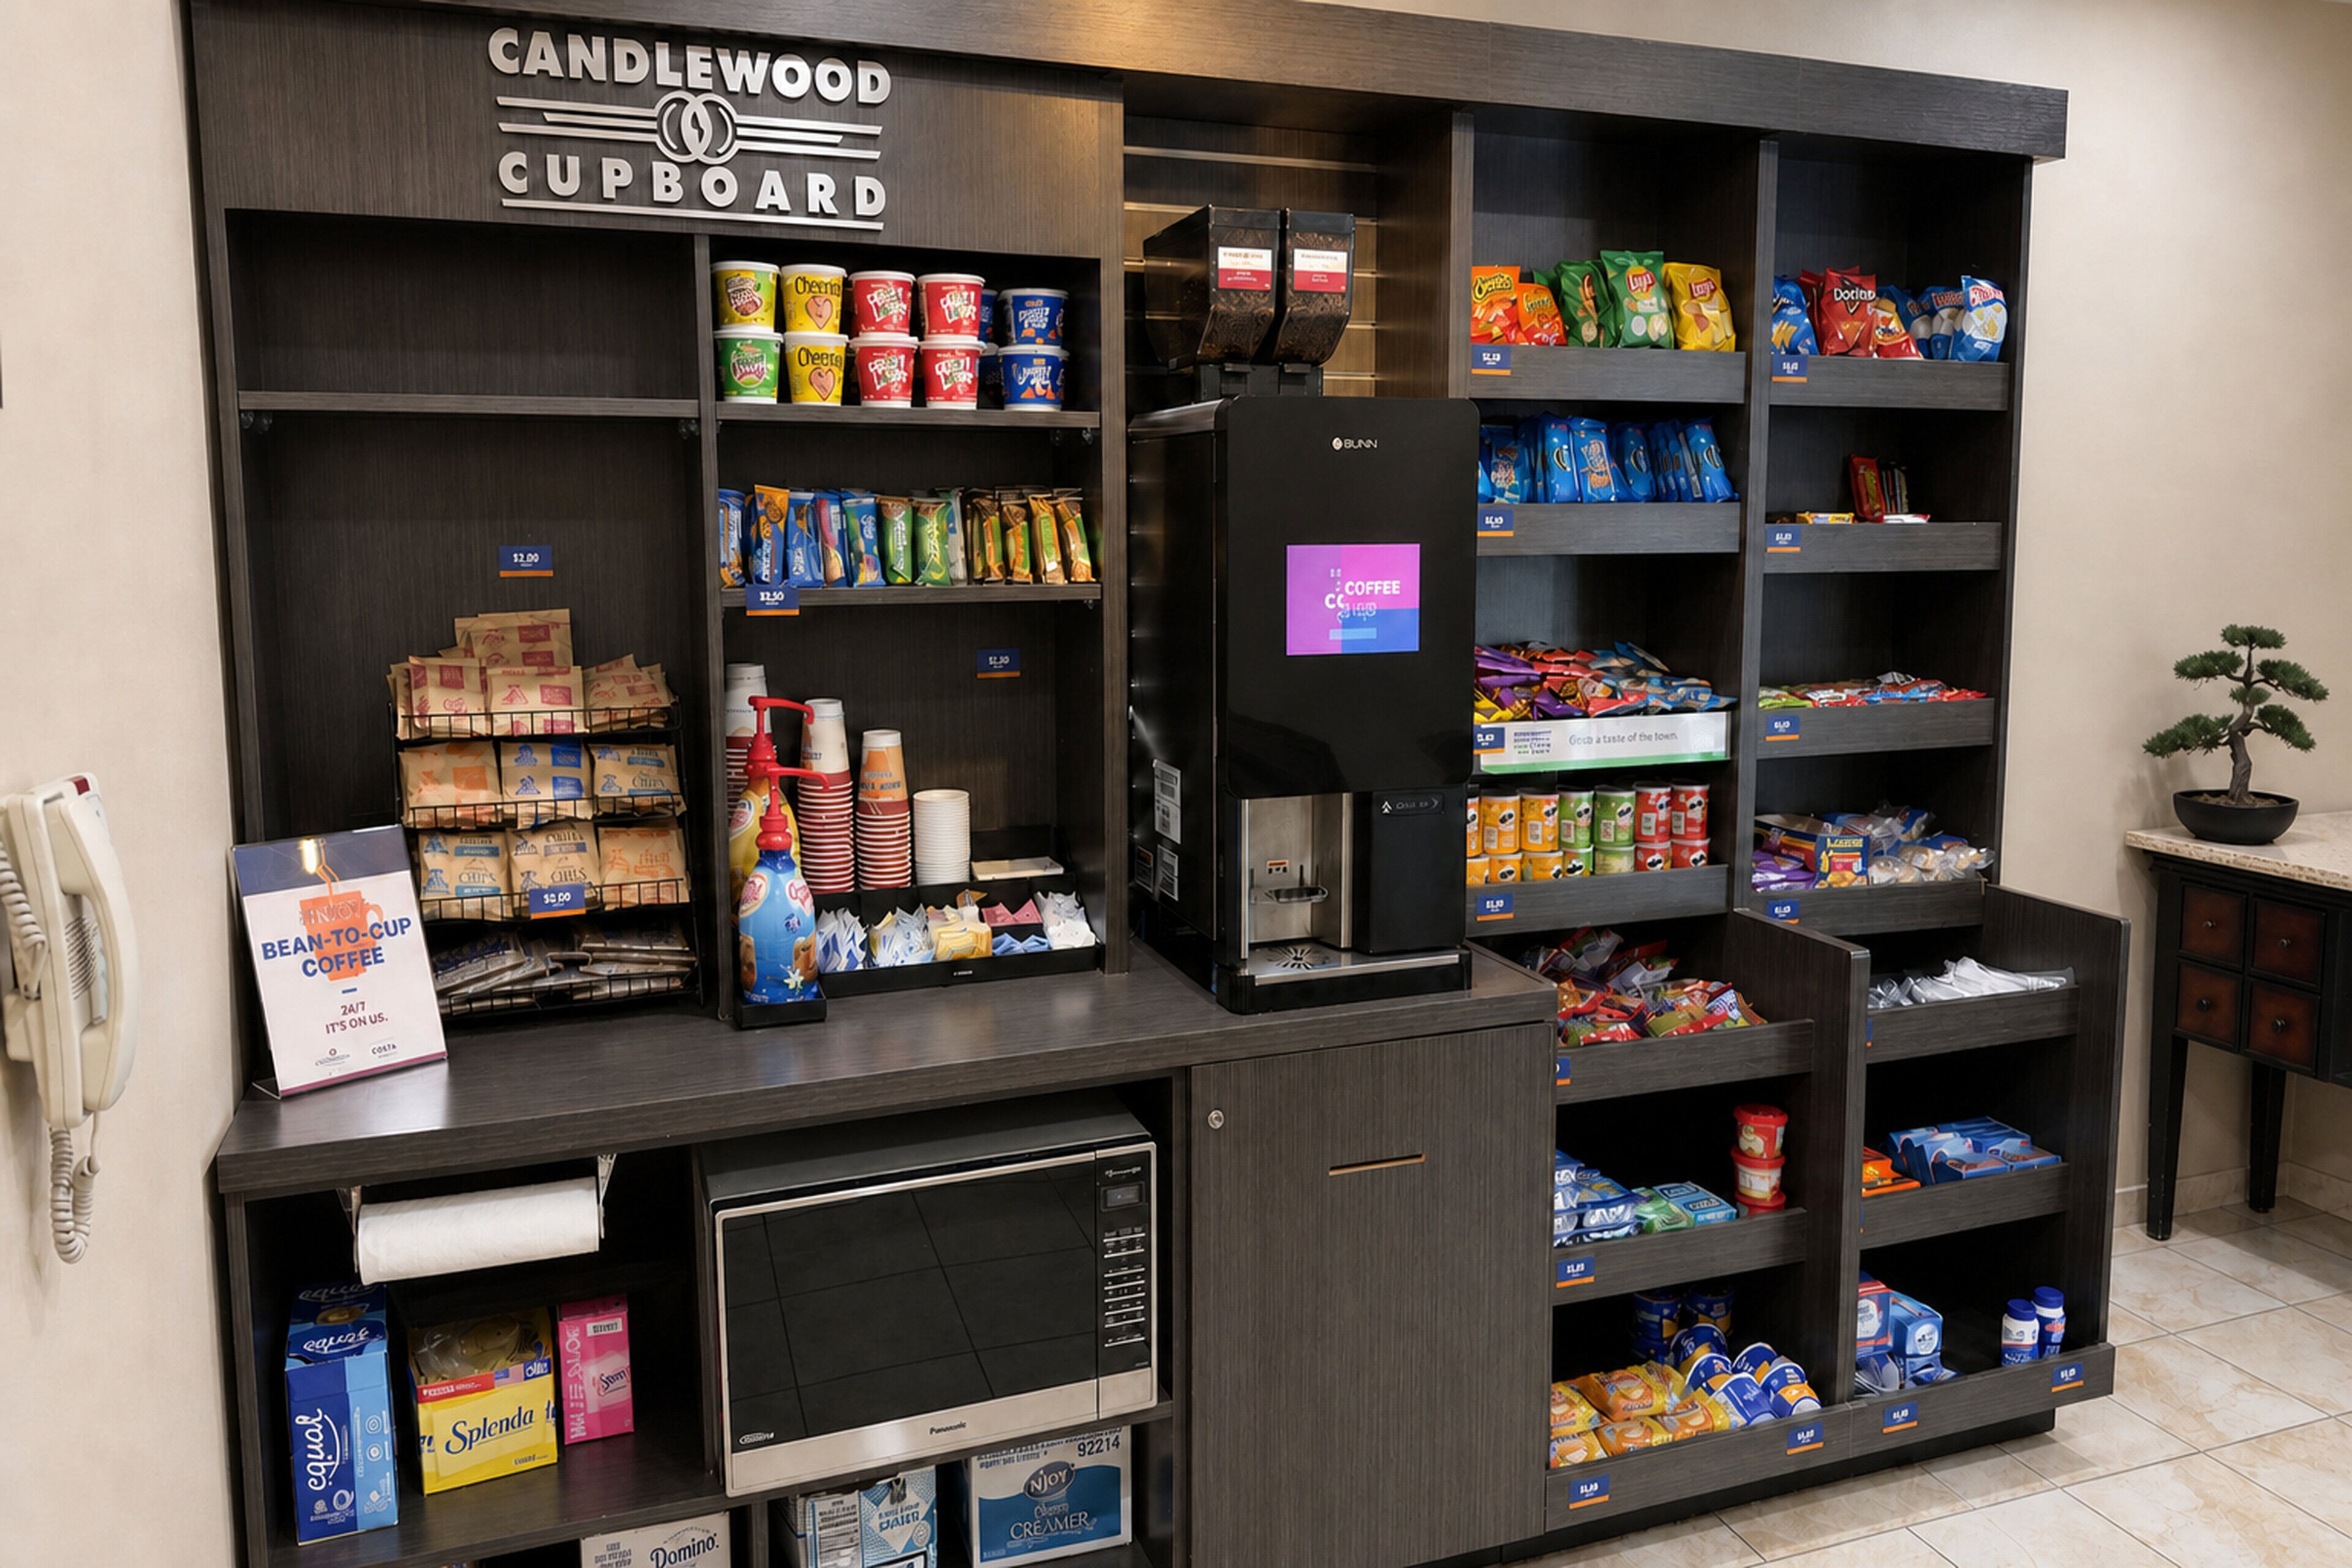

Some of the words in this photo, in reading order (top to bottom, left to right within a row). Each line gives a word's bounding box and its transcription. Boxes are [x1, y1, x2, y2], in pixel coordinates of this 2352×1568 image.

[488, 27, 891, 104] CANDLEWOOD
[499, 151, 886, 217] CUPBOARD
[1344, 439, 1378, 449] BUNN
[1345, 581, 1400, 595] COFFEE
[262, 918, 412, 960] BEAN-TO-CUP
[302, 946, 385, 977] COFFEE
[325, 1020, 347, 1035] IT'S
[349, 1016, 367, 1029] ON
[369, 1012, 388, 1025] US.
[445, 1406, 534, 1455] Splenda
[1077, 1435, 1121, 1458] 92214
[1010, 1511, 1091, 1540] CREAMER
